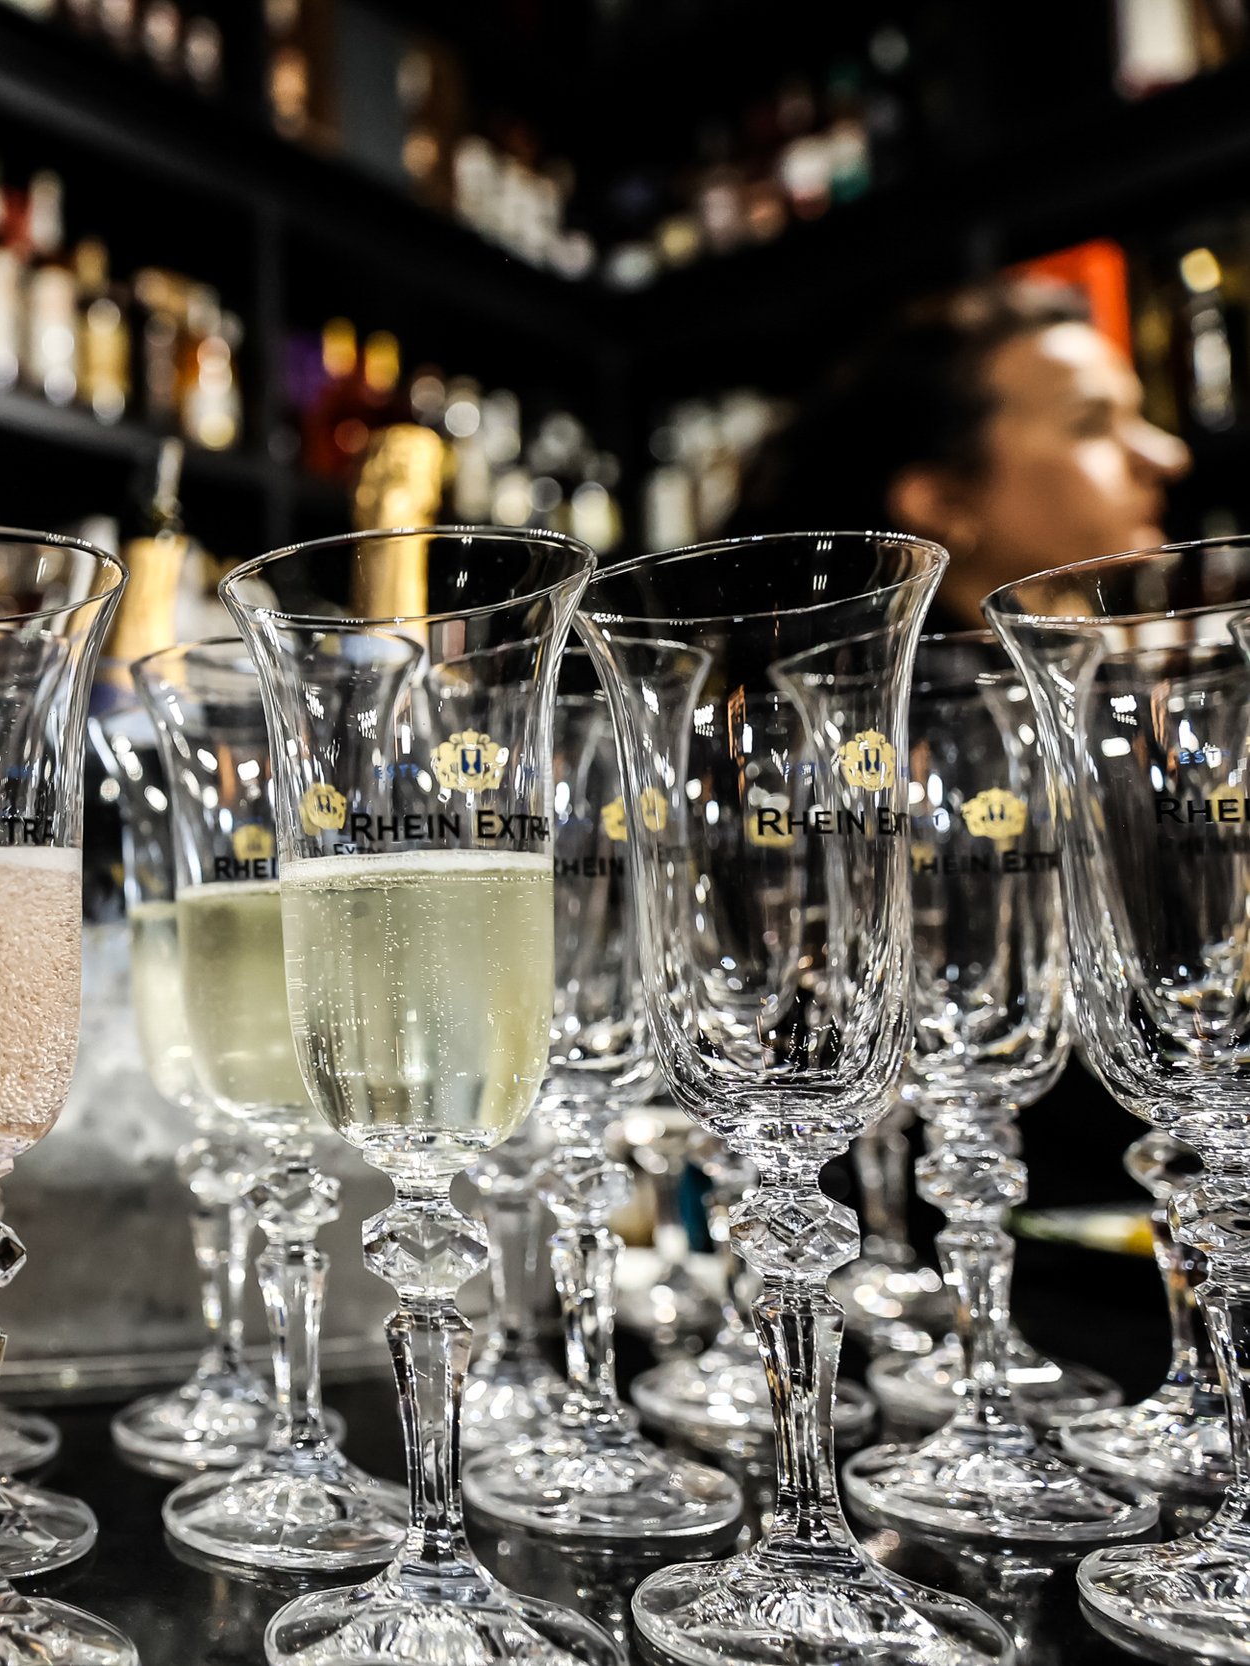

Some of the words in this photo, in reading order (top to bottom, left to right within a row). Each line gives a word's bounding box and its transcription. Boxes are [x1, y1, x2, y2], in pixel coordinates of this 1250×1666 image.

[757, 807, 865, 836] RHEIN
[1155, 798, 1250, 824] RHEI
[350, 812, 461, 842] RHEIN
[476, 810, 551, 842] EXTRA
[214, 856, 278, 880] RHEI
